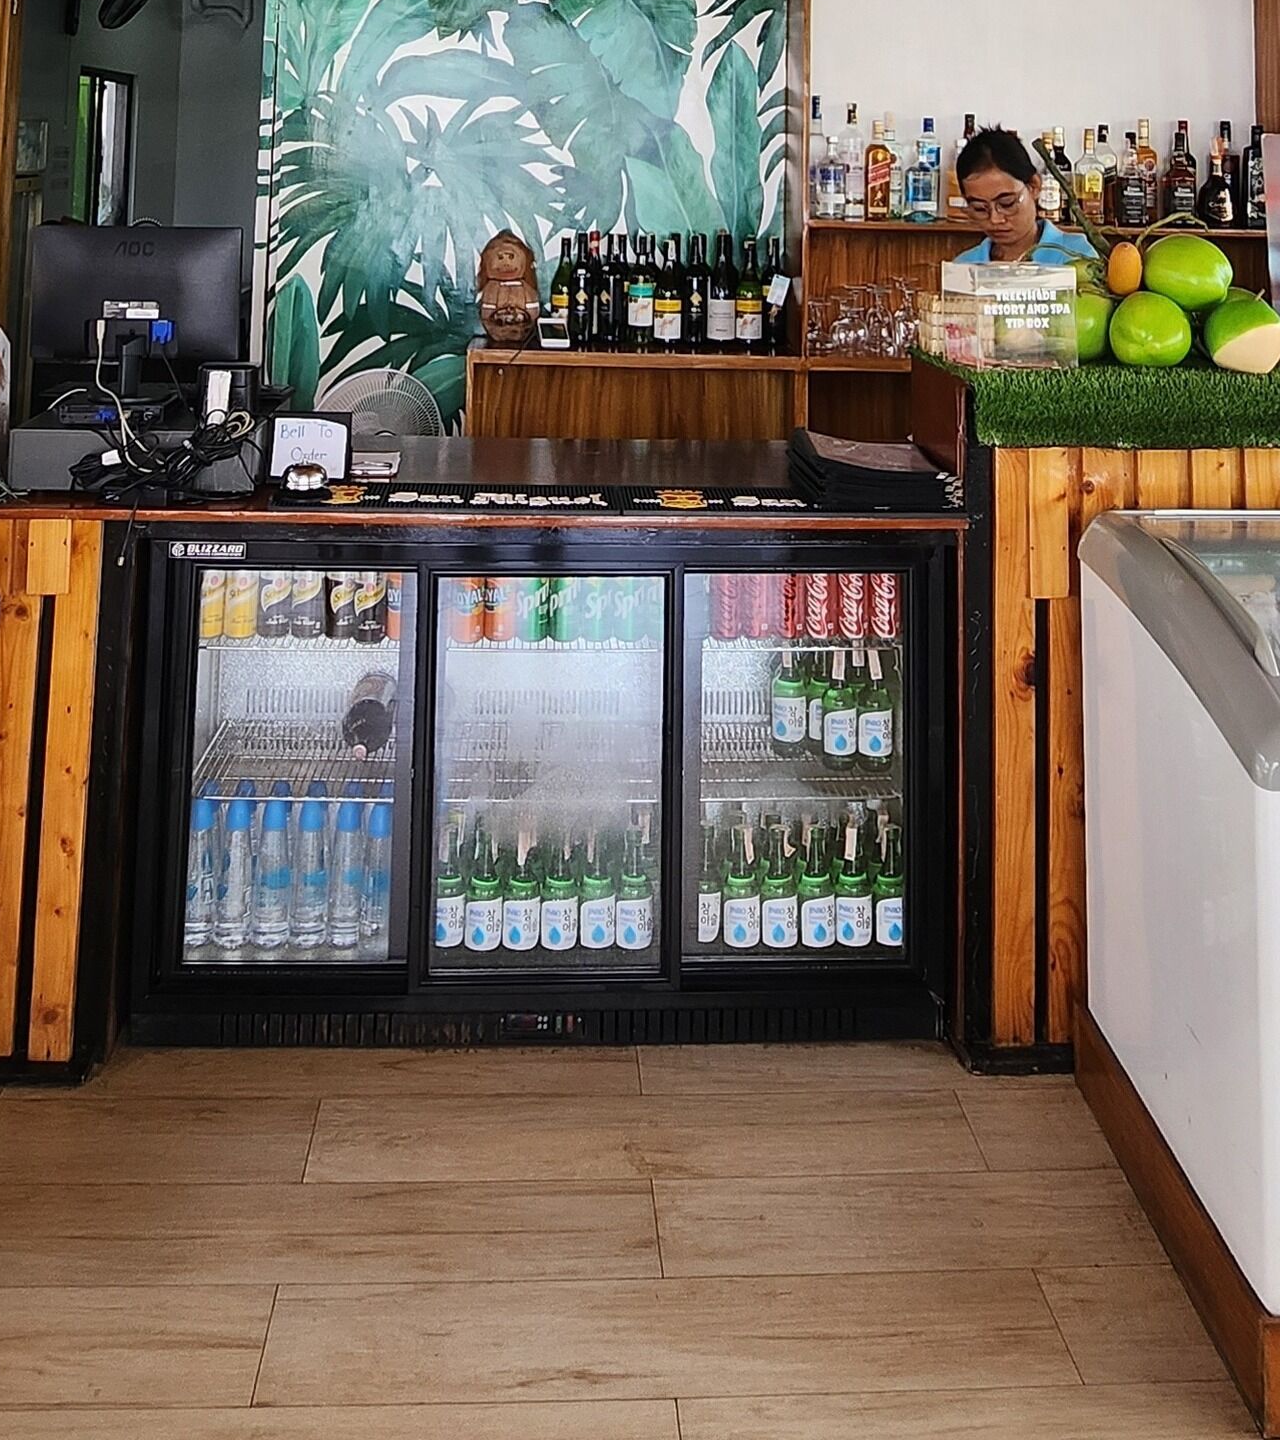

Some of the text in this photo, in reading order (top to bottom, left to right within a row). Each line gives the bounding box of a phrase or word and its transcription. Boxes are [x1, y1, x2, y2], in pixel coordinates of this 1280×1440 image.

[114, 241, 155, 257] AOC
[983, 303, 1071, 315] RESORT AND SPA
[1005, 317, 1050, 329] TIP BOX
[280, 424, 332, 439] Bell To
[291, 447, 327, 461] Order
[187, 544, 244, 553] BLIZZARD
[838, 574, 863, 639] Coca-Co
[870, 574, 896, 639] Coca-Co
